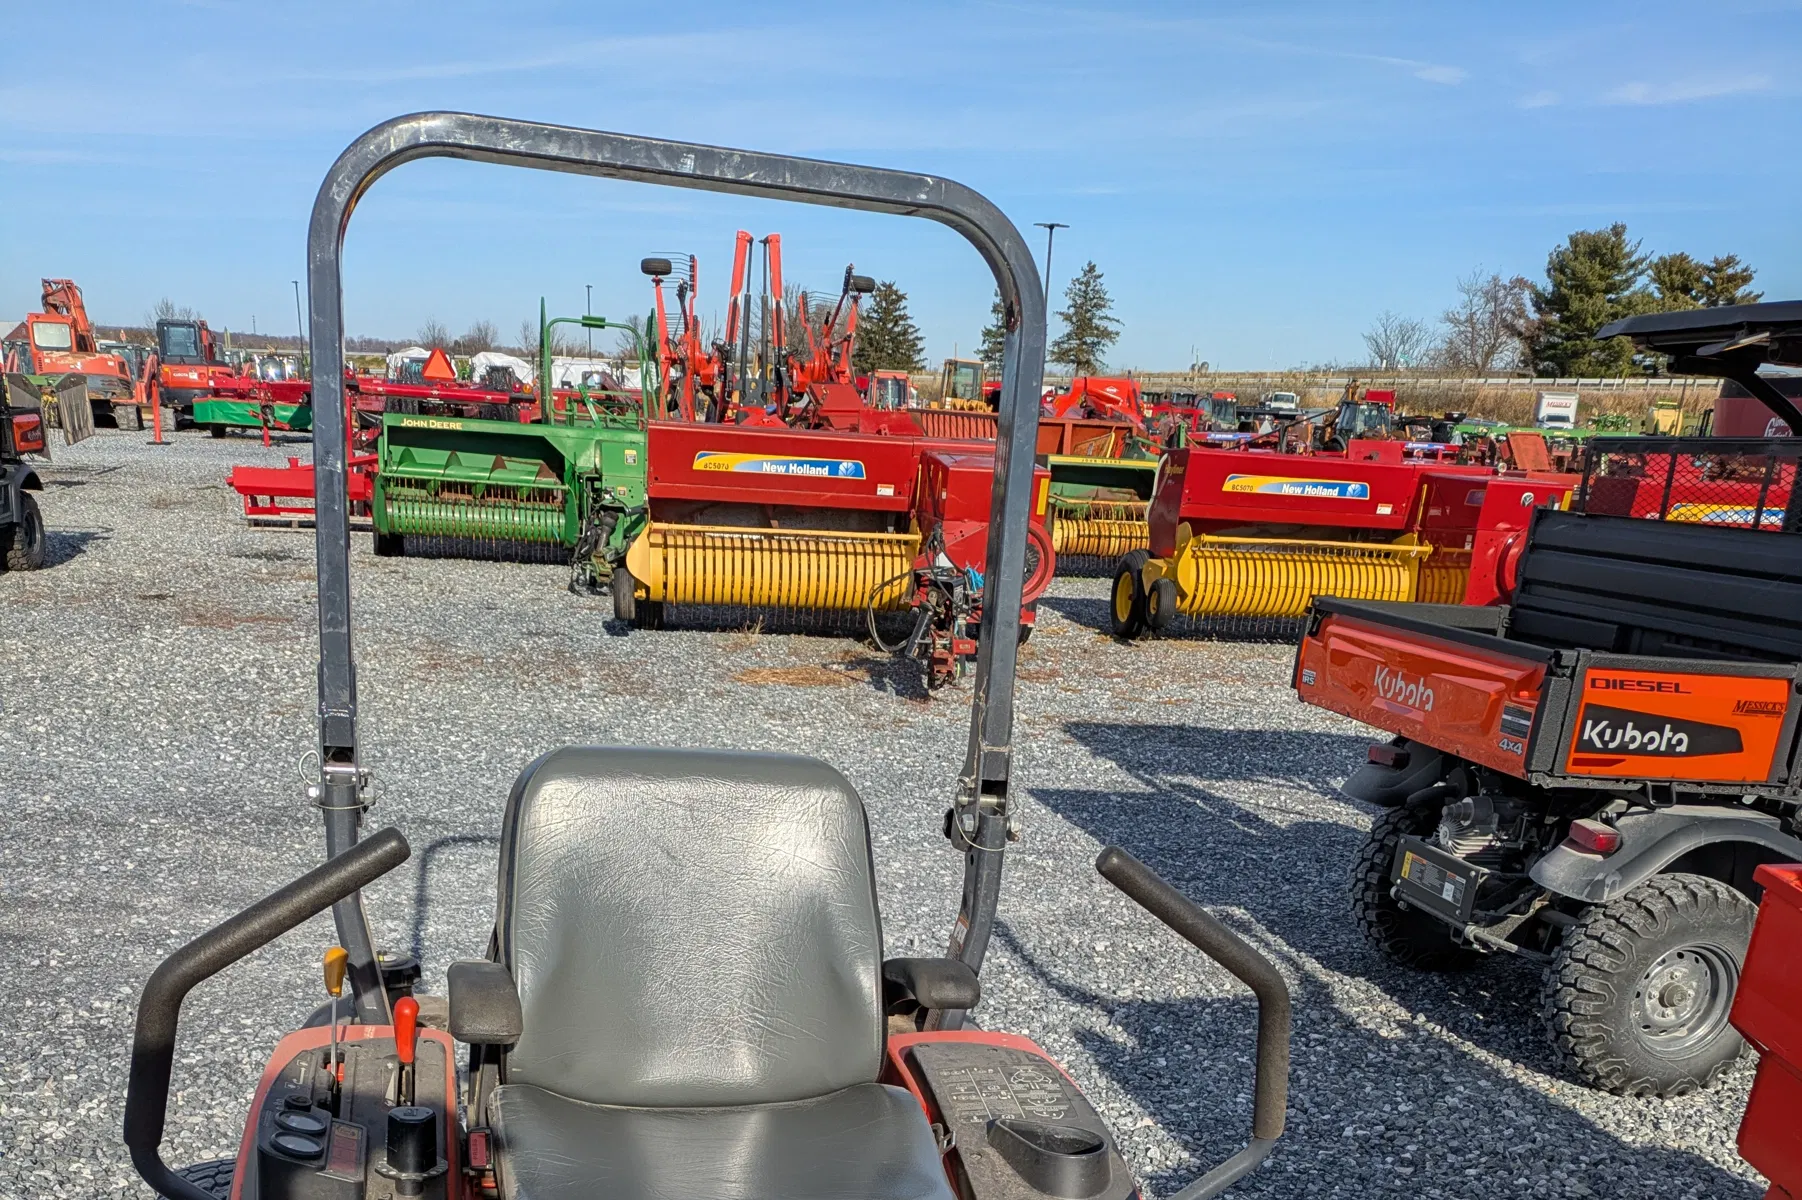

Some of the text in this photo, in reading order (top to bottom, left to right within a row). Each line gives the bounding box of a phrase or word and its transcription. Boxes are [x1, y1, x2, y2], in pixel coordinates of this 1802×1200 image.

[400, 417, 463, 430] JOHN DEERE
[762, 461, 829, 476] New Holland
[1231, 484, 1254, 492] BC5070
[1281, 483, 1339, 497] New Holland
[1302, 675, 1315, 685] IRS
[1590, 677, 1692, 695] DIESEL
[1373, 665, 1434, 712] Kubota
[1582, 719, 1689, 753] Kubota
[1498, 738, 1523, 755] 4x4
